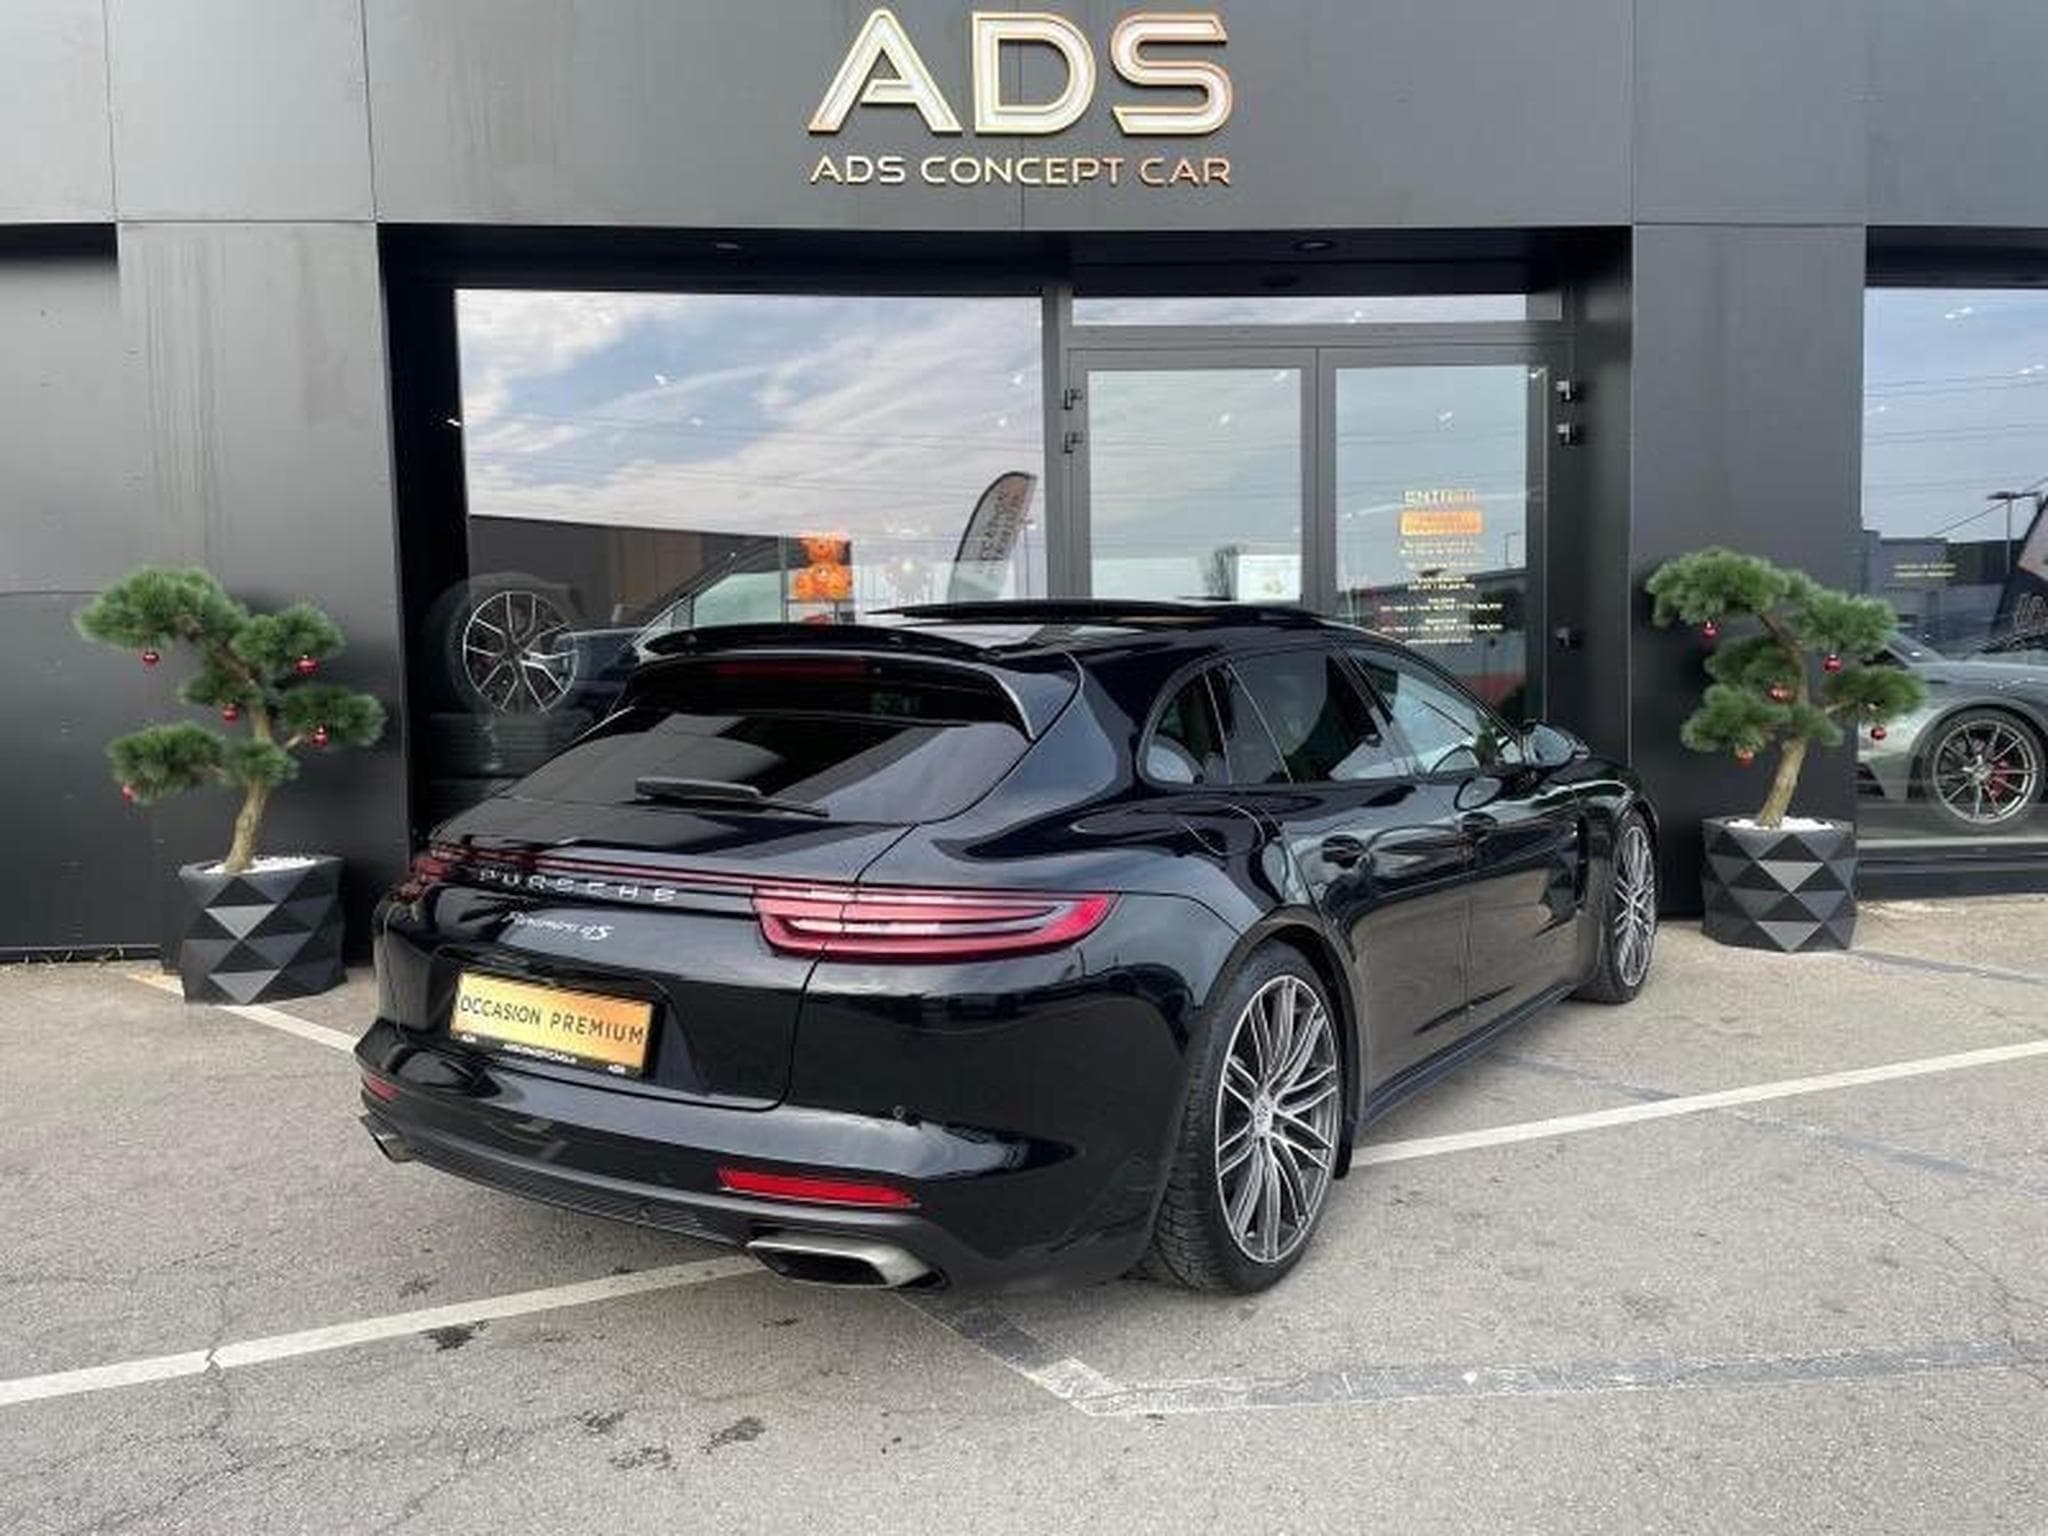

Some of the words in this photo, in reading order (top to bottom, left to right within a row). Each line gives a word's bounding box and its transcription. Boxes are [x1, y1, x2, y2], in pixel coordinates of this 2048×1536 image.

[808, 9, 1233, 134] ADS
[810, 155, 906, 184] ADS
[920, 155, 1125, 186] CONCEPT
[1139, 156, 1231, 186] CAR
[459, 994, 541, 1026] OCCASION
[550, 1011, 645, 1045] PREMIUM
